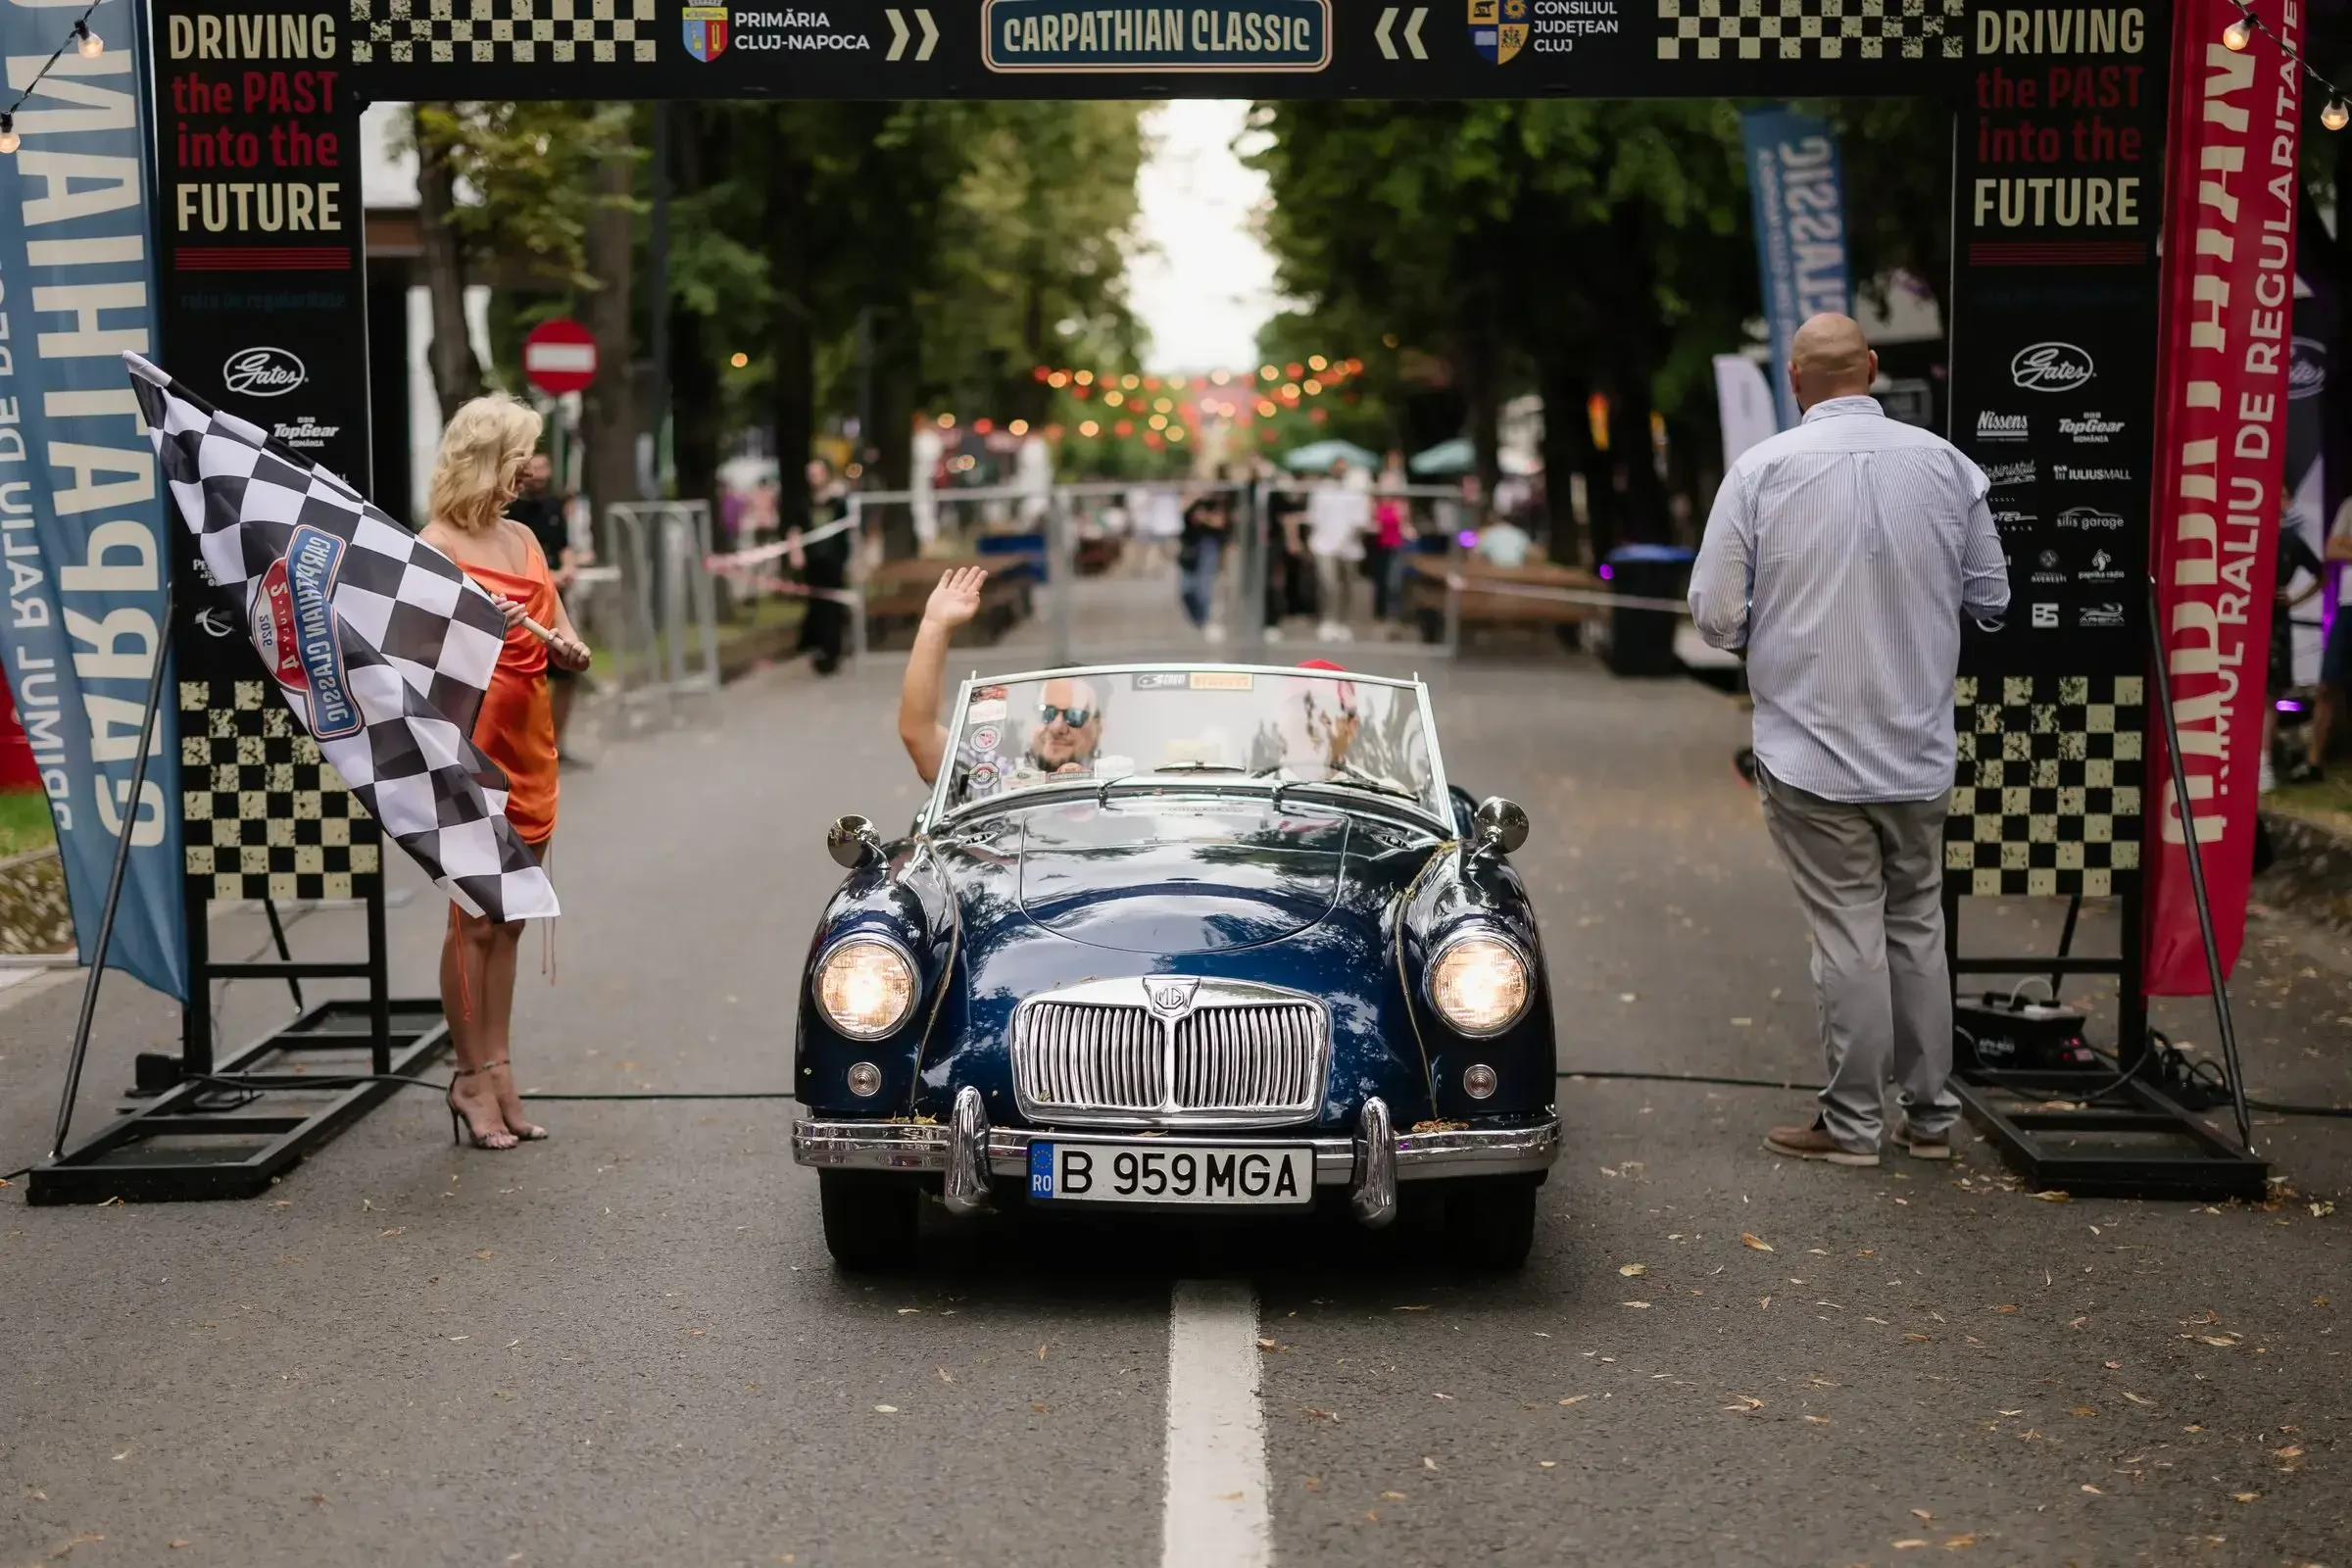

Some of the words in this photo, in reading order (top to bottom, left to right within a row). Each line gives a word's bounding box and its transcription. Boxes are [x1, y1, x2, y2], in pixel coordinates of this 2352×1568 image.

[735, 9, 831, 27] PRIMĂRIA
[1534, 1, 1618, 15] CONSILIUL
[1534, 20, 1619, 37] JUDEȚEAN
[170, 14, 336, 60] DRIVING
[735, 34, 870, 51] CLUJ-NAPOCA
[1004, 9, 1184, 52] CARPATHIAN
[1193, 9, 1310, 52] CLASSIC
[1534, 39, 1573, 52] CLUJ
[1976, 8, 2144, 55] DRIVING
[172, 74, 232, 114] the
[243, 72, 337, 114] PAST
[1977, 67, 2036, 109] the
[2049, 67, 2144, 108] PAST
[177, 122, 258, 168] into
[270, 121, 338, 167] the
[1978, 118, 2059, 163] into
[2073, 117, 2140, 161] the
[177, 183, 342, 231] FUTURE
[1974, 177, 2140, 227] FUTURE
[2245, 0, 2297, 374] REGULARITATE
[226, 353, 300, 391] Gates
[2014, 348, 2087, 387] Gates
[273, 423, 340, 440] TopGear
[1977, 411, 2028, 429] Nissens
[2058, 418, 2126, 435] TopGear
[2234, 392, 2275, 460] DE
[2082, 517, 2125, 530] garage
[2217, 477, 2264, 624] RALIU
[1158, 987, 1182, 1005] MG
[1033, 1174, 1053, 1192] RO
[1061, 1151, 1093, 1194] B
[1113, 1152, 1198, 1197] 959
[1205, 1153, 1298, 1197] MGA
